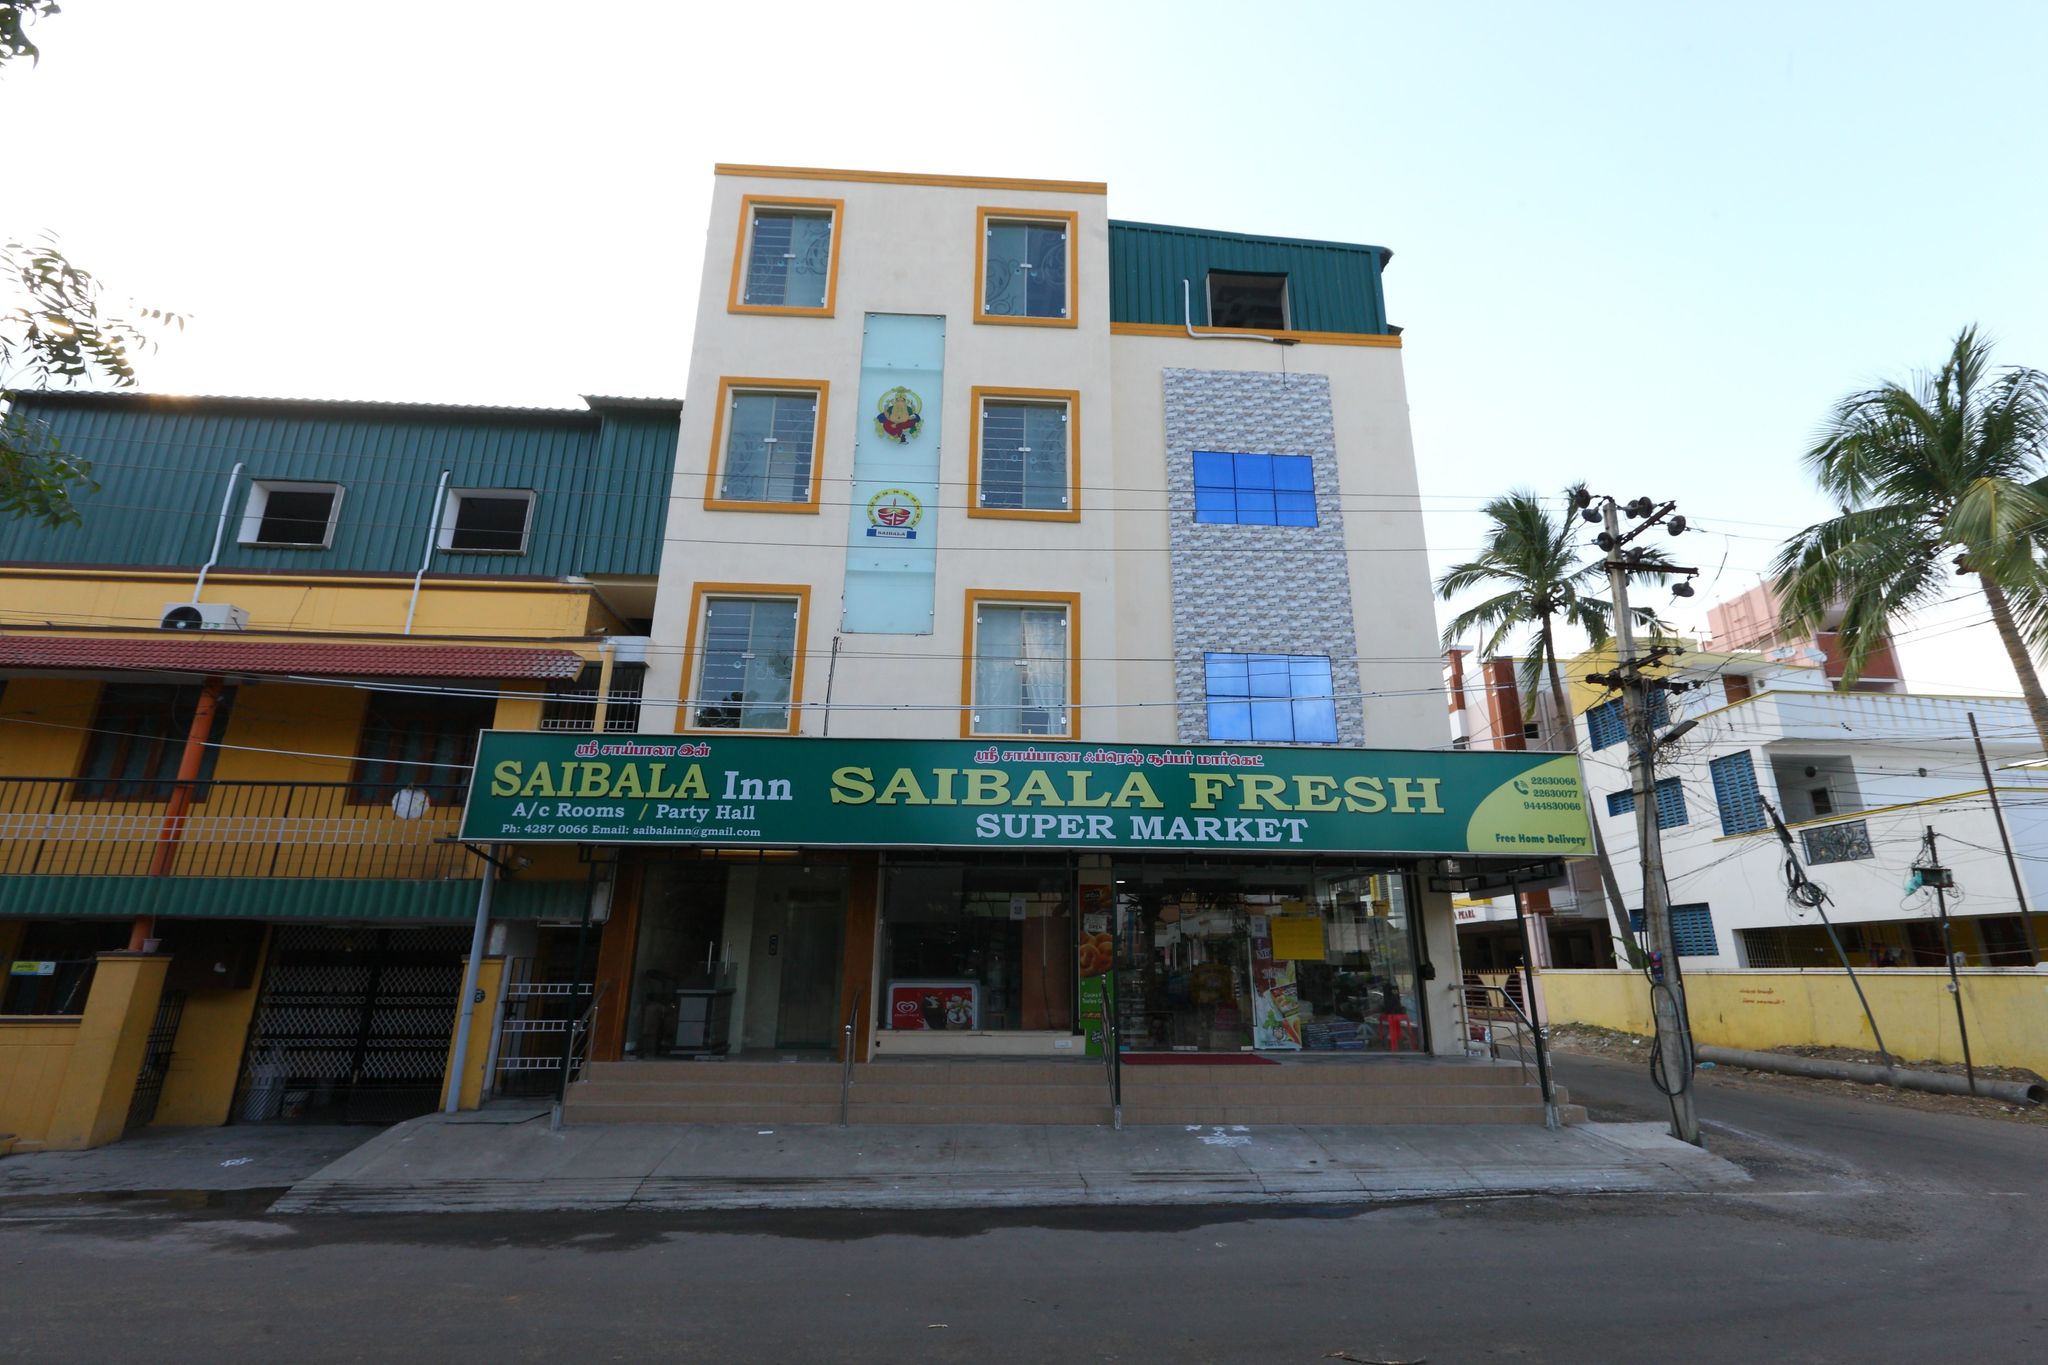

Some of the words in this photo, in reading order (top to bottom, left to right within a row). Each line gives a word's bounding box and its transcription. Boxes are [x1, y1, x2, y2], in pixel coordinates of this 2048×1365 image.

[678, 742, 711, 757] இன்
[491, 760, 710, 799] SAIBALA
[722, 770, 793, 801] Inn
[1531, 777, 1576, 785] 22630066
[829, 767, 1165, 809] SAIBALA
[1189, 772, 1446, 814] FRESH
[1533, 790, 1577, 798] 22630077
[511, 802, 551, 819] A/c
[556, 803, 625, 818] Rooms
[655, 804, 710, 823] Party
[715, 806, 756, 820] Hall
[501, 823, 521, 833] Ph:
[524, 824, 556, 834] 4287
[558, 824, 588, 834] 0066
[591, 825, 630, 835] Email:
[632, 825, 762, 838] saibalainn@gmail.com
[975, 813, 1117, 840] SUPER
[1129, 816, 1309, 844] MARKET
[1495, 833, 1517, 843] Free
[1518, 834, 1546, 844] Home
[1546, 834, 1586, 846] Delivery
